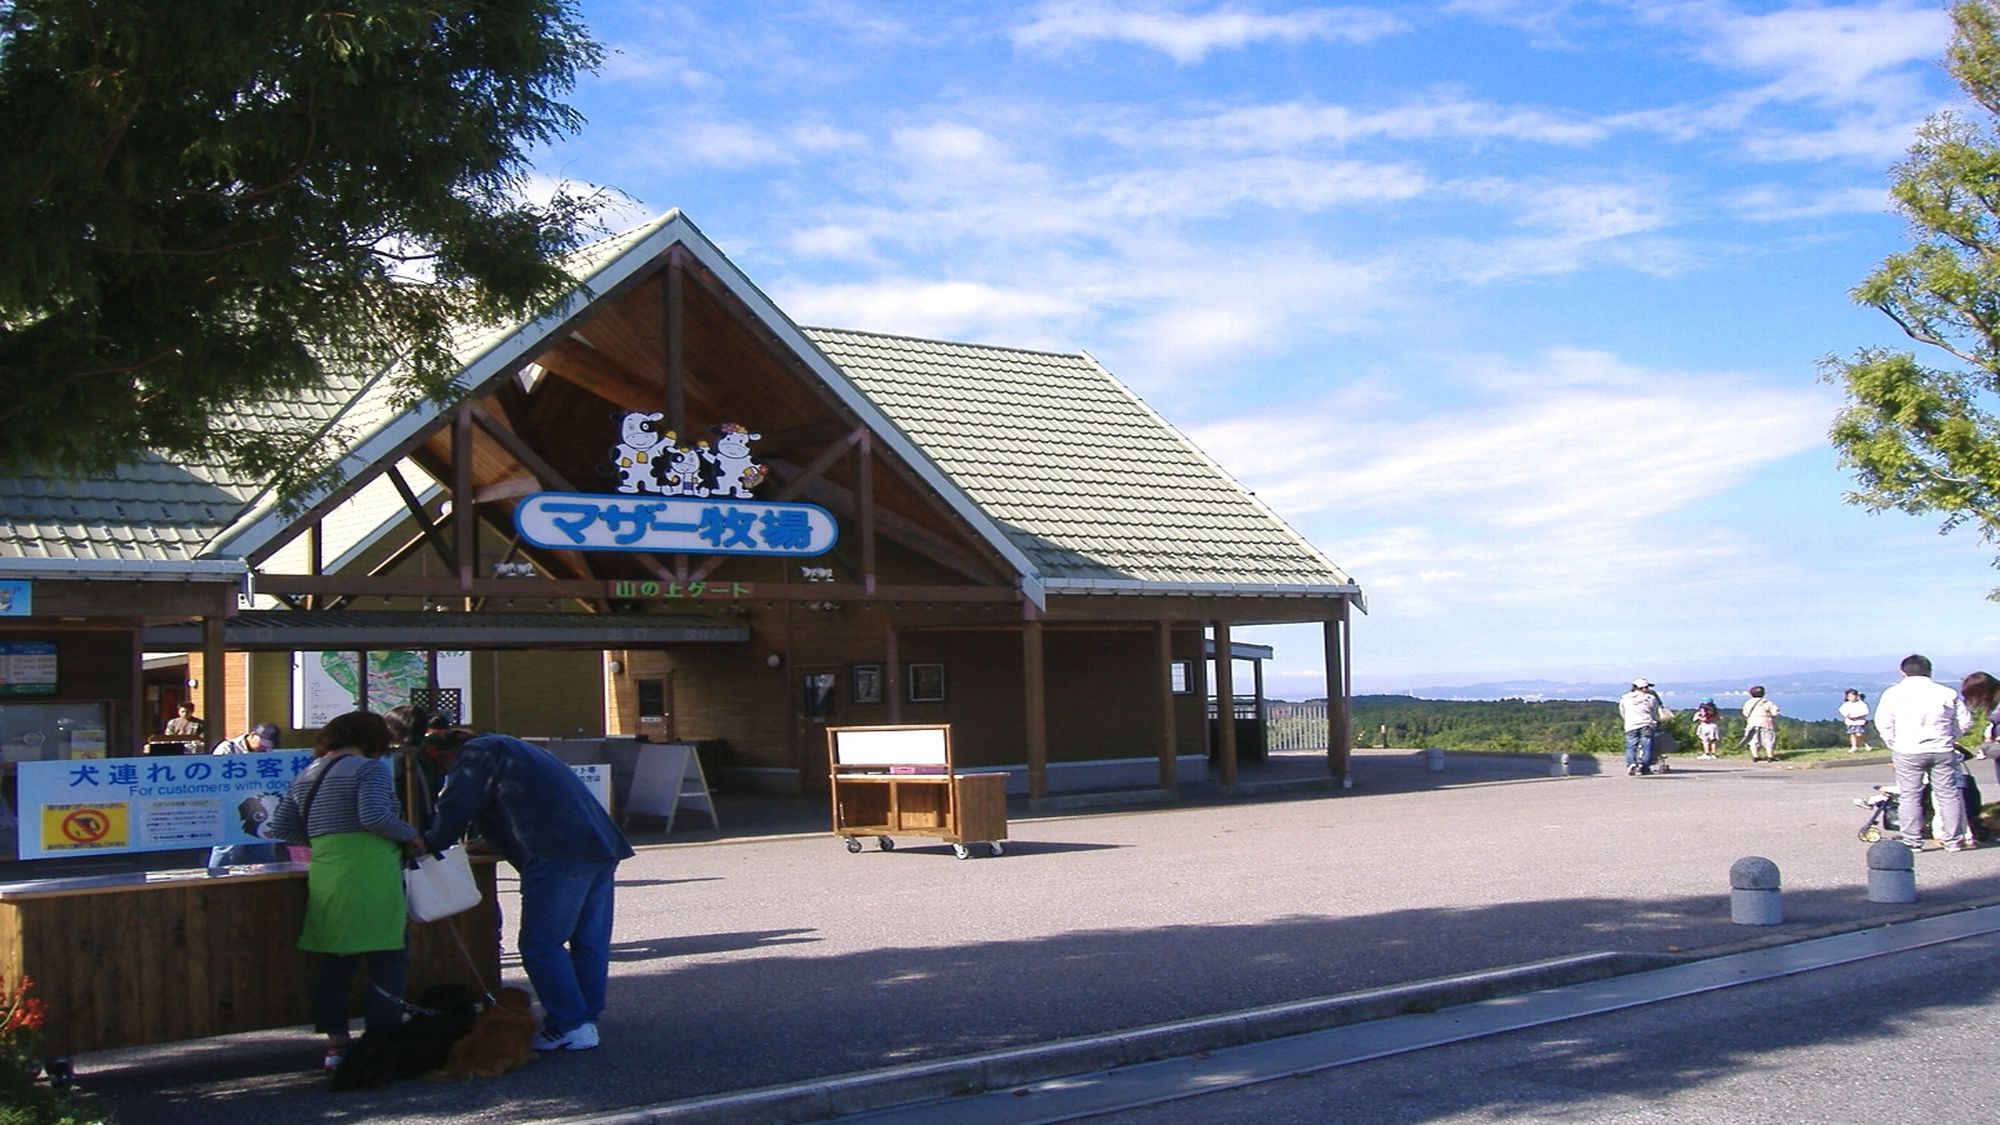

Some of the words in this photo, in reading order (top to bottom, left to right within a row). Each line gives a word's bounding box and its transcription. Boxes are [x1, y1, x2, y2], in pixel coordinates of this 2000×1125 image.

[540, 502, 813, 550] マザー牧場
[615, 581, 751, 598] 山の上ゲート
[129, 785, 153, 797] For
[158, 782, 231, 796] customers
[235, 779, 262, 791] with
